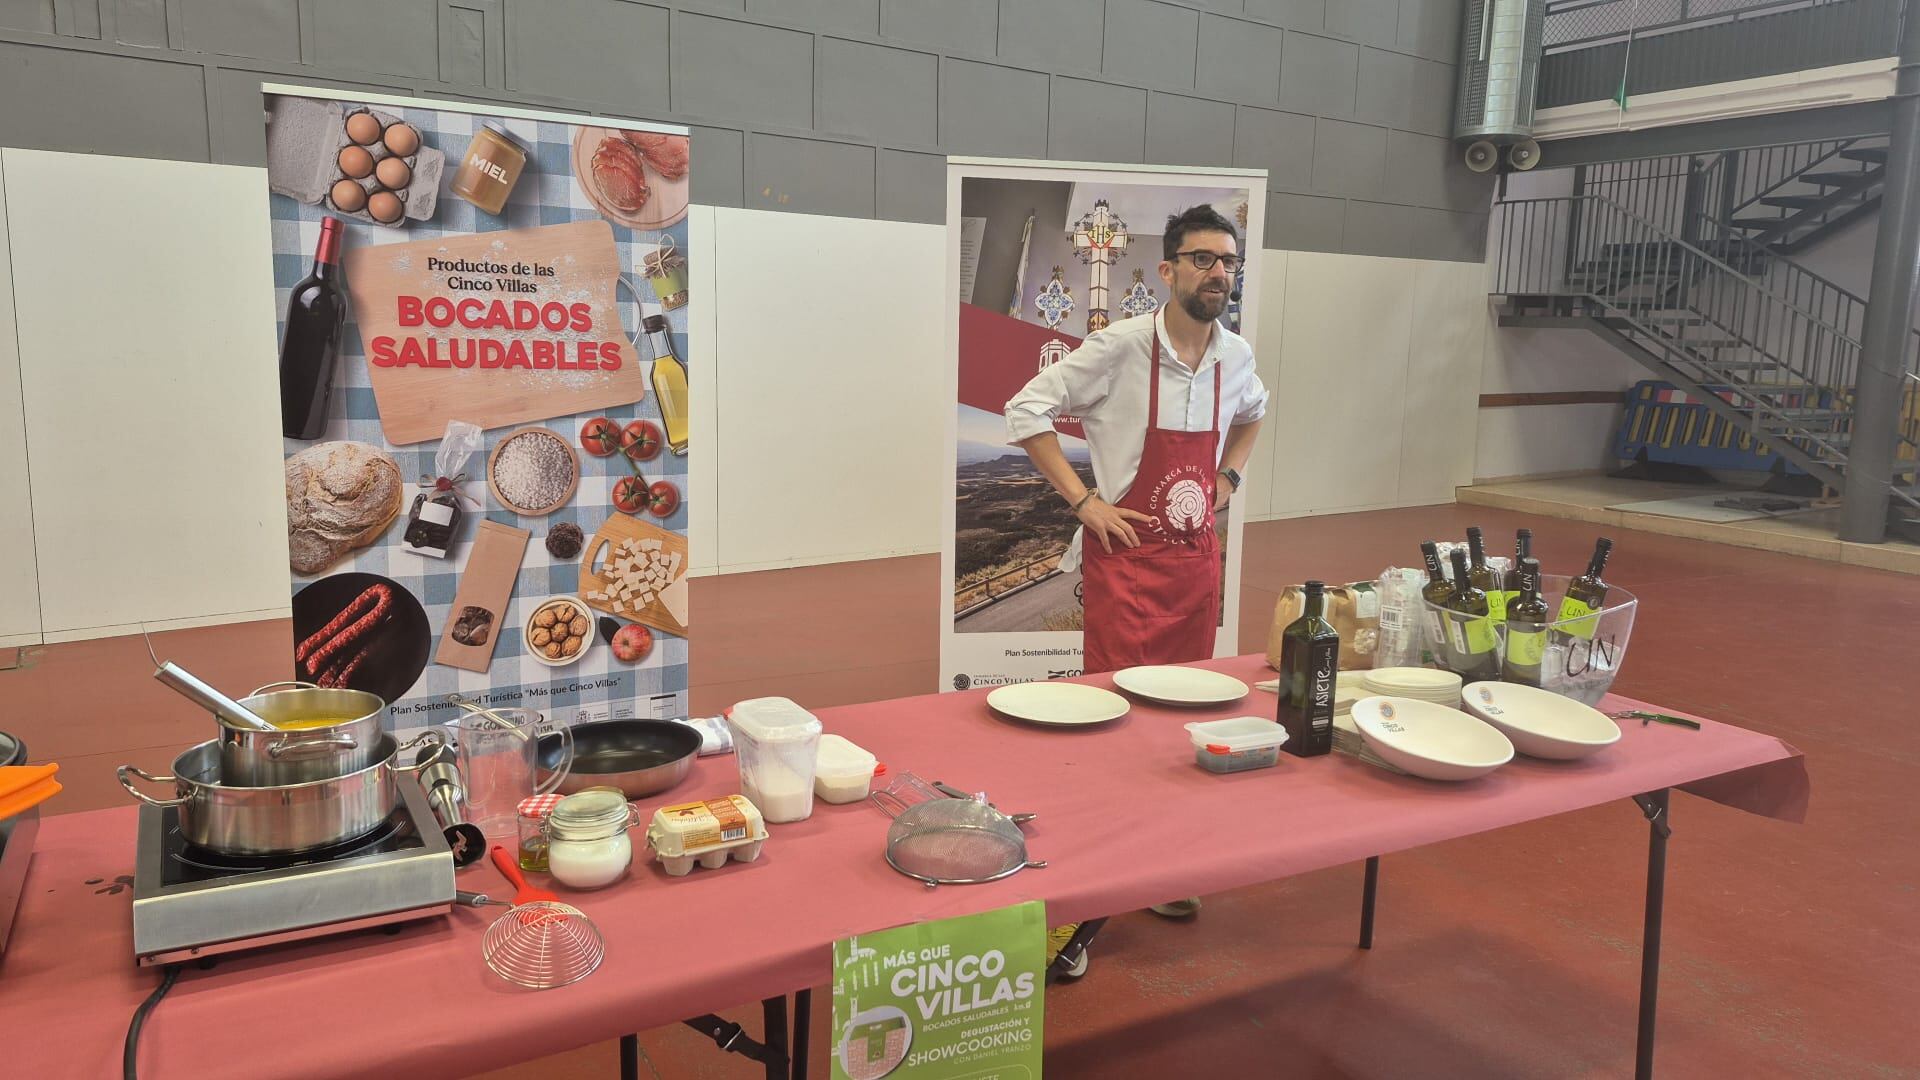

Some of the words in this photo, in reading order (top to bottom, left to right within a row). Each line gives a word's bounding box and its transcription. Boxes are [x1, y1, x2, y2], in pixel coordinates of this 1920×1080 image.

[470, 153, 508, 185] MIEL
[427, 257, 508, 275] Productos
[511, 262, 532, 275] de
[534, 262, 555, 277] las
[447, 276, 493, 291] Cinco
[495, 277, 538, 293] Villas
[397, 295, 593, 333] BOCADOS
[371, 335, 623, 371] SALUDABLES
[1149, 467, 1182, 510] COMARCA
[1005, 649, 1021, 657] Plan
[1022, 648, 1071, 657] Sostenibilidad
[973, 678, 1003, 686] CINCO
[1066, 669, 1083, 678] GO
[390, 706, 412, 716] Plan
[484, 691, 523, 704] Turística
[550, 686, 567, 696] que
[569, 682, 594, 692] Cinco
[883, 949, 917, 969] MÁS
[920, 944, 951, 961] QUE
[890, 949, 1006, 998] CINCO
[915, 971, 1035, 1021] VILLAS
[922, 1018, 961, 1033] BOCADOS
[963, 1007, 1009, 1023] SALUDABLES
[960, 1017, 1022, 1039] DEGUSTACIÓN
[1023, 1017, 1031, 1025] Y
[908, 1028, 1033, 1067] SHOWCOOKING
[953, 1055, 972, 1065] CON
